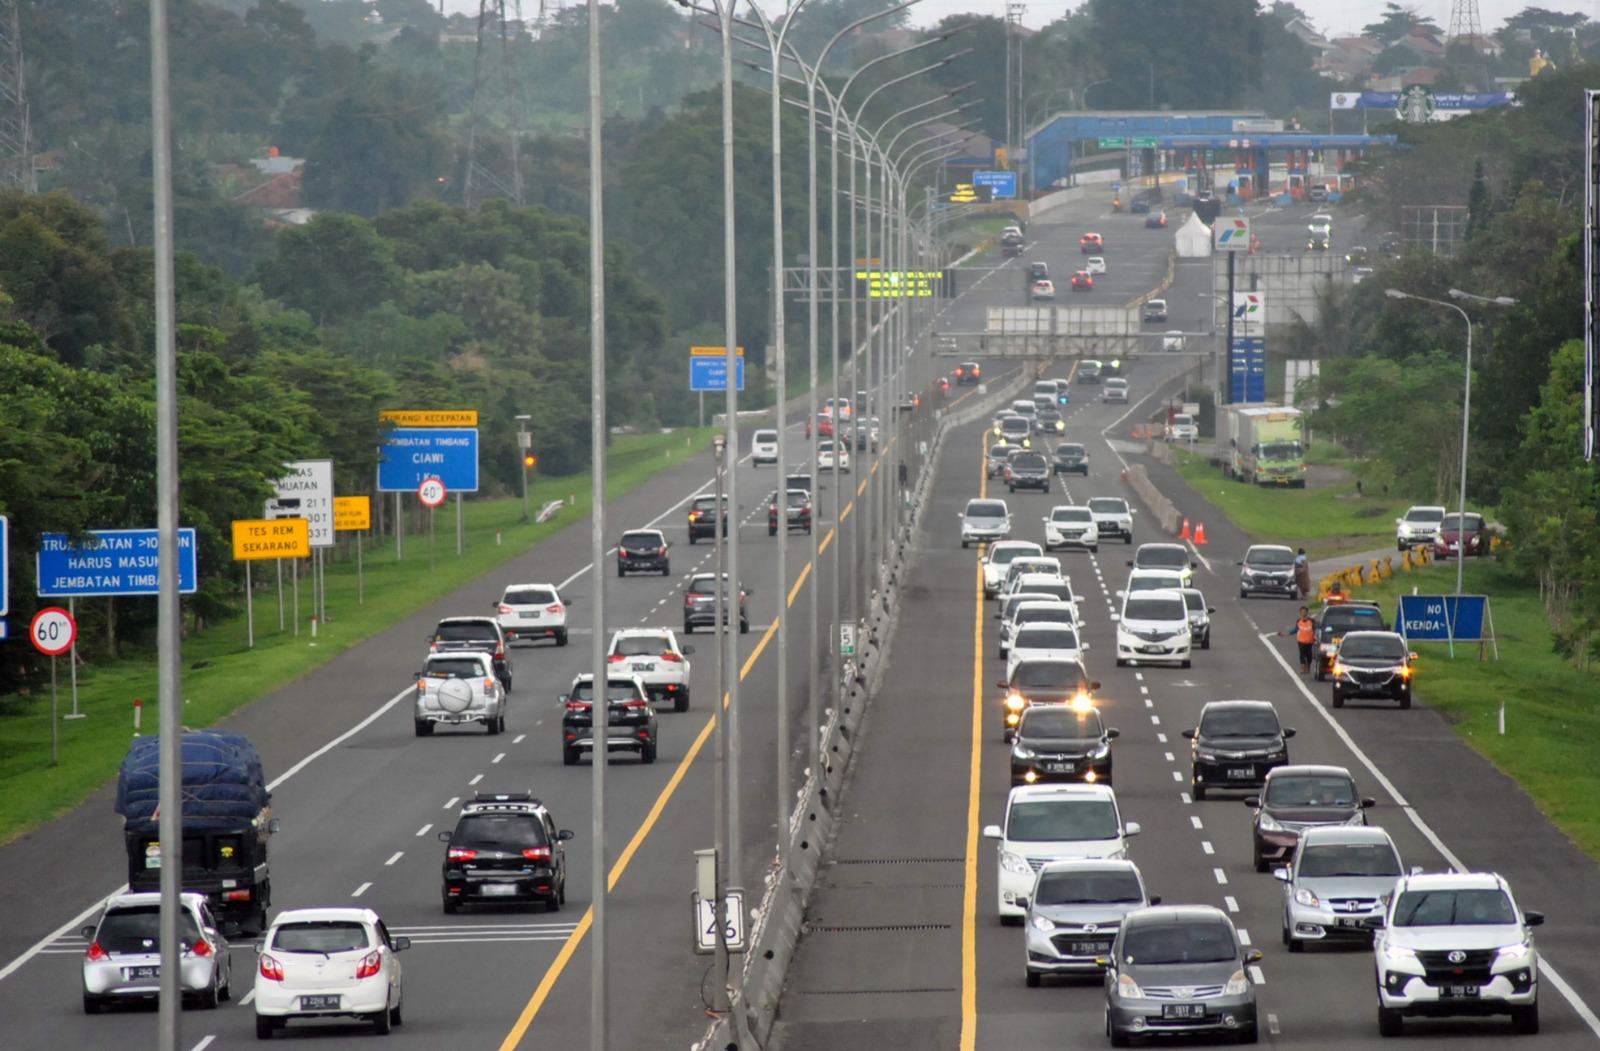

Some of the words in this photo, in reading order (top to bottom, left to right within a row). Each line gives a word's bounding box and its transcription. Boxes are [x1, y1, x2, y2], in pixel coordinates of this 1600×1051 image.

[425, 414, 472, 422] KECEPATAN
[435, 438, 470, 447] TIMBANG
[412, 453, 444, 463] CIAWI
[278, 481, 318, 491] MUATAN
[307, 498, 317, 508] 21
[248, 527, 267, 536] TES
[273, 526, 294, 535] REM
[138, 537, 158, 549] >10
[243, 541, 298, 552] SEKARANG
[68, 557, 112, 569] HARUS
[52, 576, 120, 588] JEMBATAN
[1427, 604, 1442, 615] NO
[38, 621, 59, 641] 60
